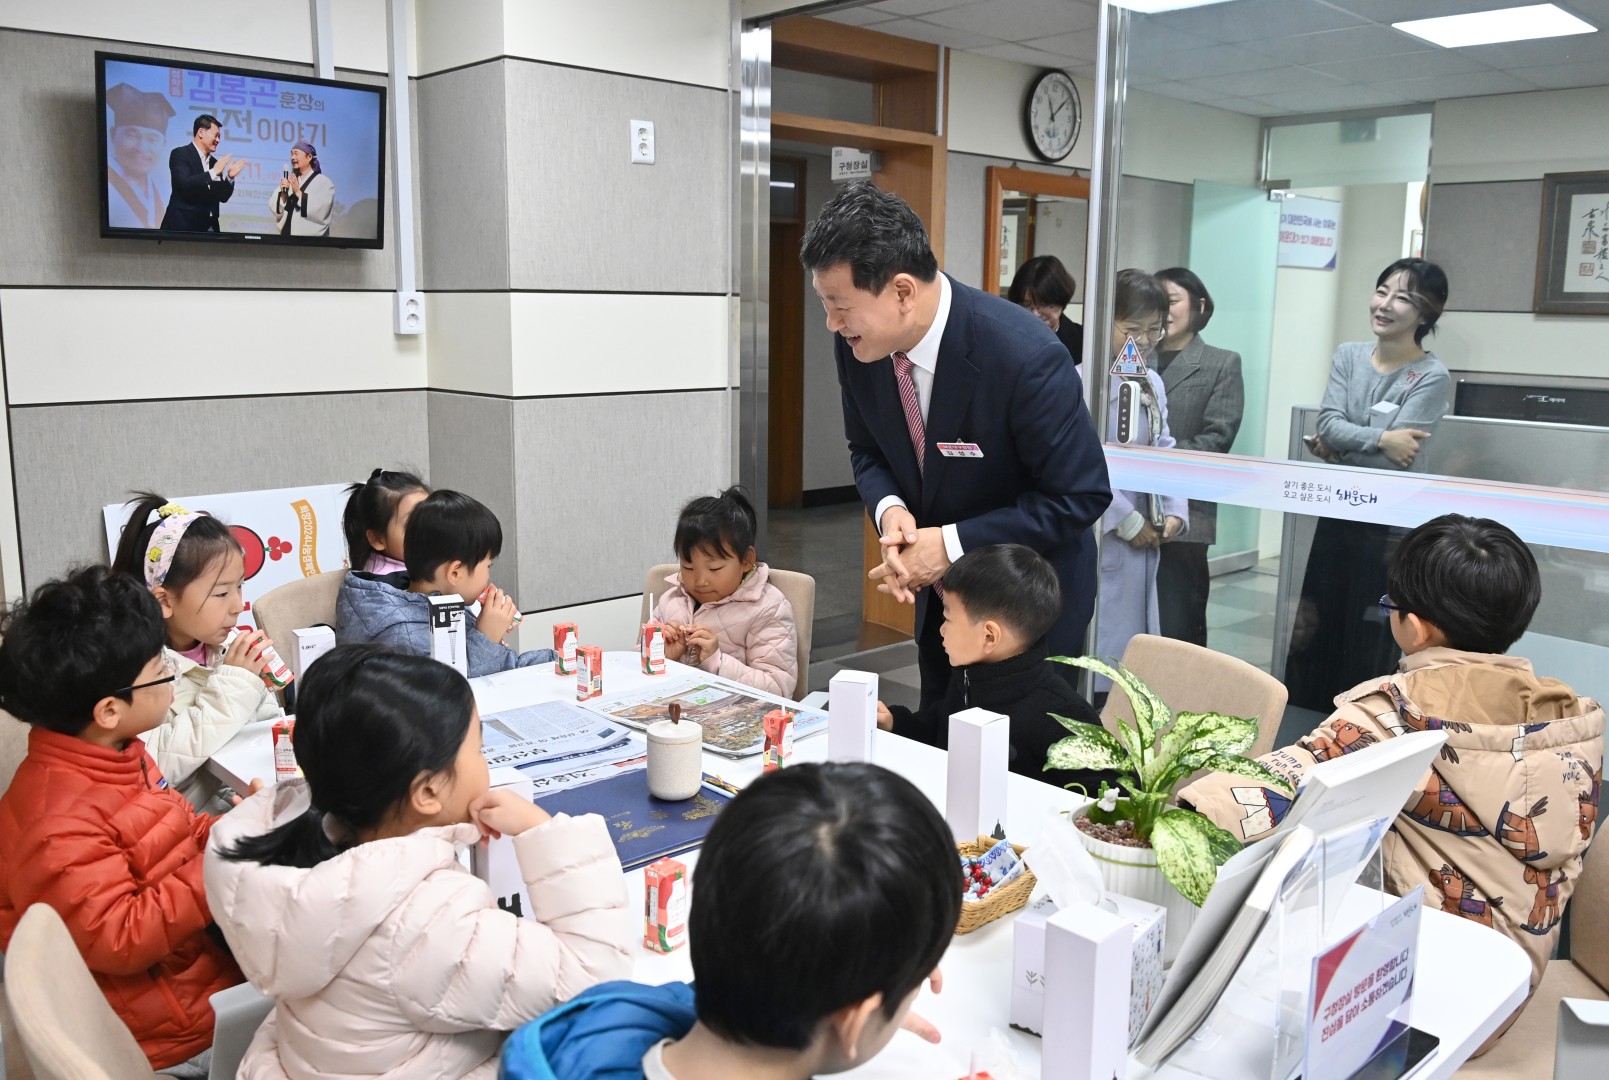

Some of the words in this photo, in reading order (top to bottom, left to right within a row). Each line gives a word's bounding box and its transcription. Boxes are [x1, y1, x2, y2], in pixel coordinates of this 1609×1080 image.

[280, 90, 325, 112] 훈장의
[257, 117, 327, 147] 이야기
[839, 160, 868, 171] 구청장실
[1284, 480, 1299, 490] 살기
[1301, 481, 1315, 492] 좋은
[1316, 483, 1331, 493] 도시
[1300, 493, 1314, 502] 싶은
[1315, 494, 1331, 504] 도시
[1335, 488, 1378, 506] 해운대
[1323, 988, 1353, 1022] 구청장실
[1354, 972, 1375, 999] 방문을
[1375, 947, 1409, 983] 환영합니다
[1321, 1014, 1345, 1043] 진심을
[1345, 1003, 1360, 1025] 담아
[1360, 966, 1407, 1013] 소통하겠습니다
